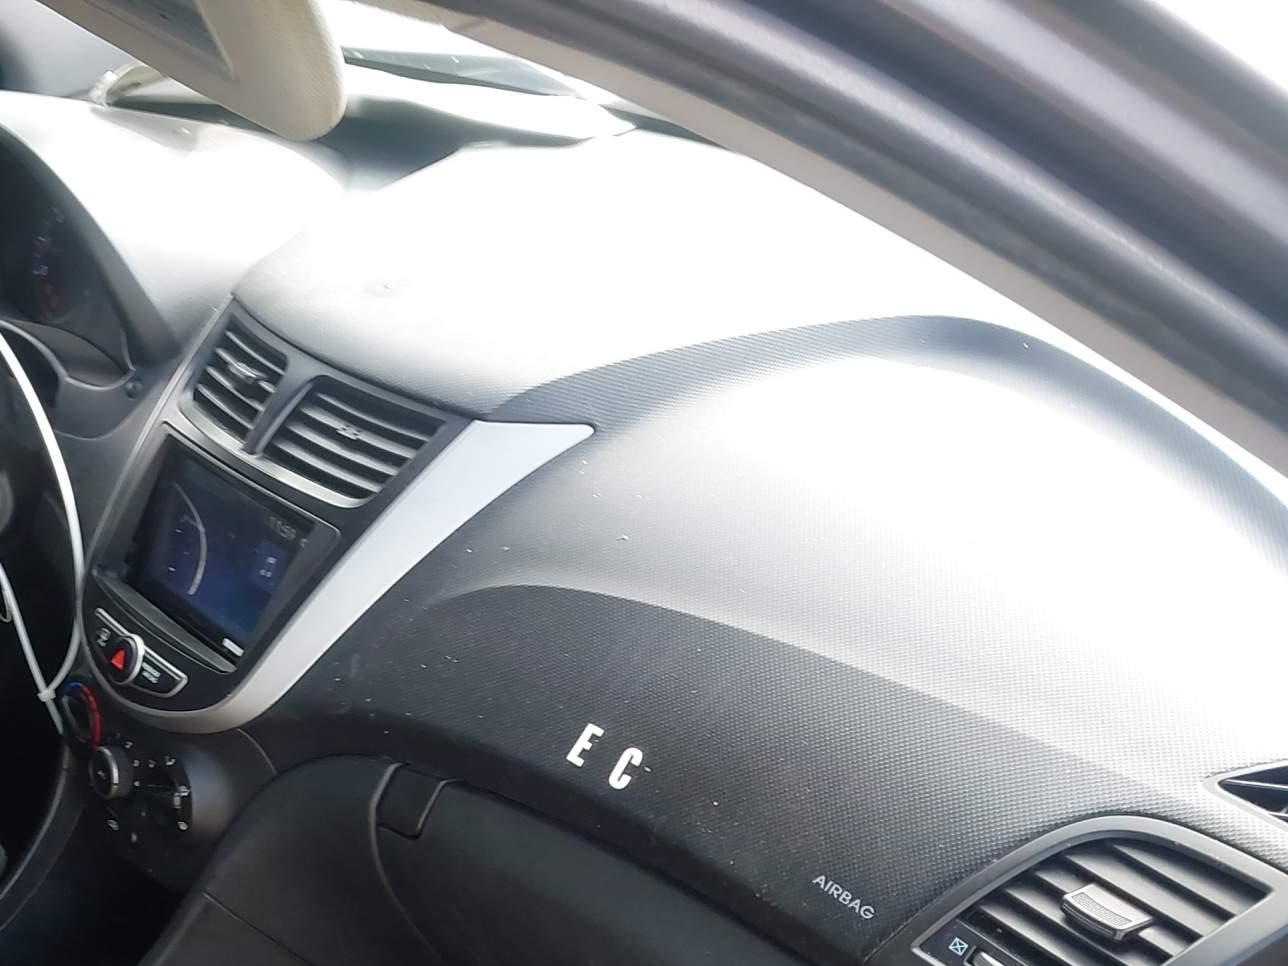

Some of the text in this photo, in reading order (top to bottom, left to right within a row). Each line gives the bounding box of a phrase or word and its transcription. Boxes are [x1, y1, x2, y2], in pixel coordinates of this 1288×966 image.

[566, 722, 643, 790] E C
[812, 875, 875, 919] AIRBAG
